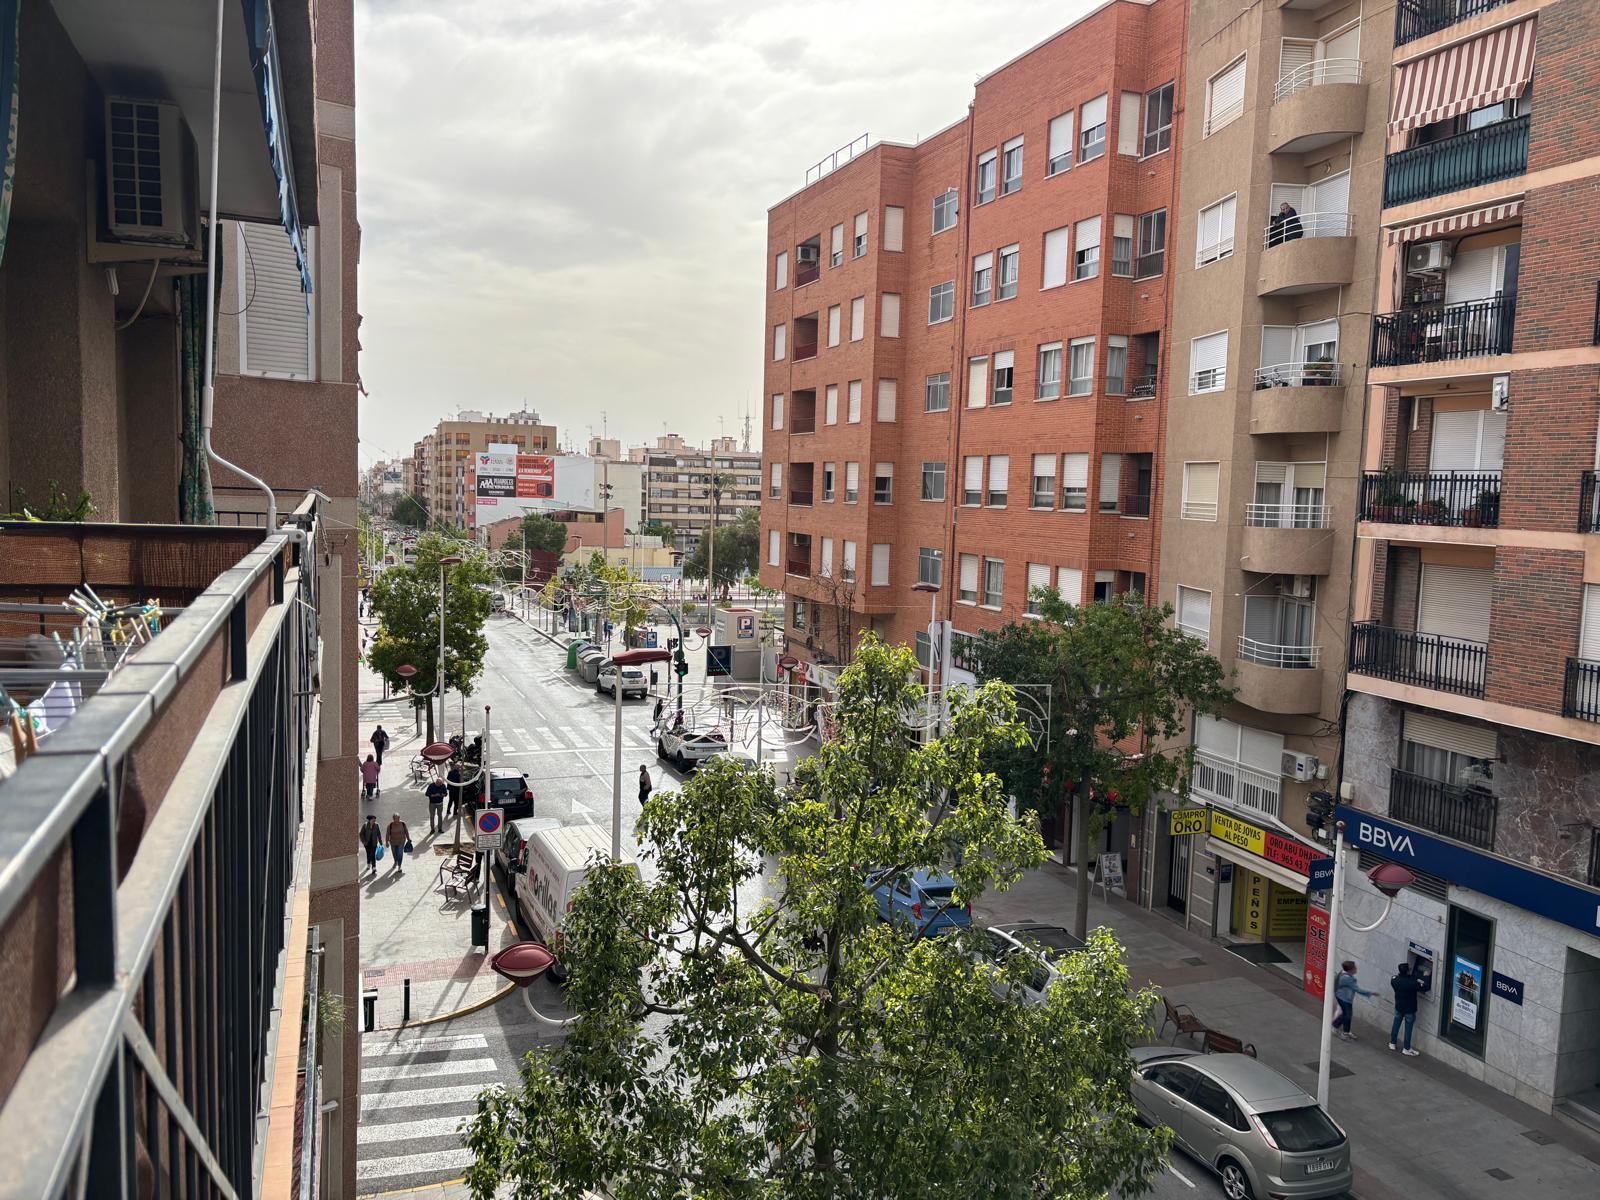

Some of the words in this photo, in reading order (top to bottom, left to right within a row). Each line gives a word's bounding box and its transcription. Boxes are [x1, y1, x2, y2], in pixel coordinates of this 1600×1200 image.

[1173, 811, 1205, 819] COMPRO
[1174, 820, 1202, 833] ORO
[1214, 814, 1232, 829] VENTA
[1234, 822, 1241, 833] DE
[1243, 826, 1260, 840] JOYAS
[1225, 830, 1231, 840] AL
[1233, 834, 1248, 846] PESO
[1270, 837, 1282, 849] ORO
[1284, 843, 1297, 855] ABU
[1360, 822, 1415, 856] BBVA
[1282, 854, 1293, 865] 965
[1295, 859, 1303, 868] 43
[1310, 926, 1326, 940] SE
[1496, 980, 1519, 996] BBVA
